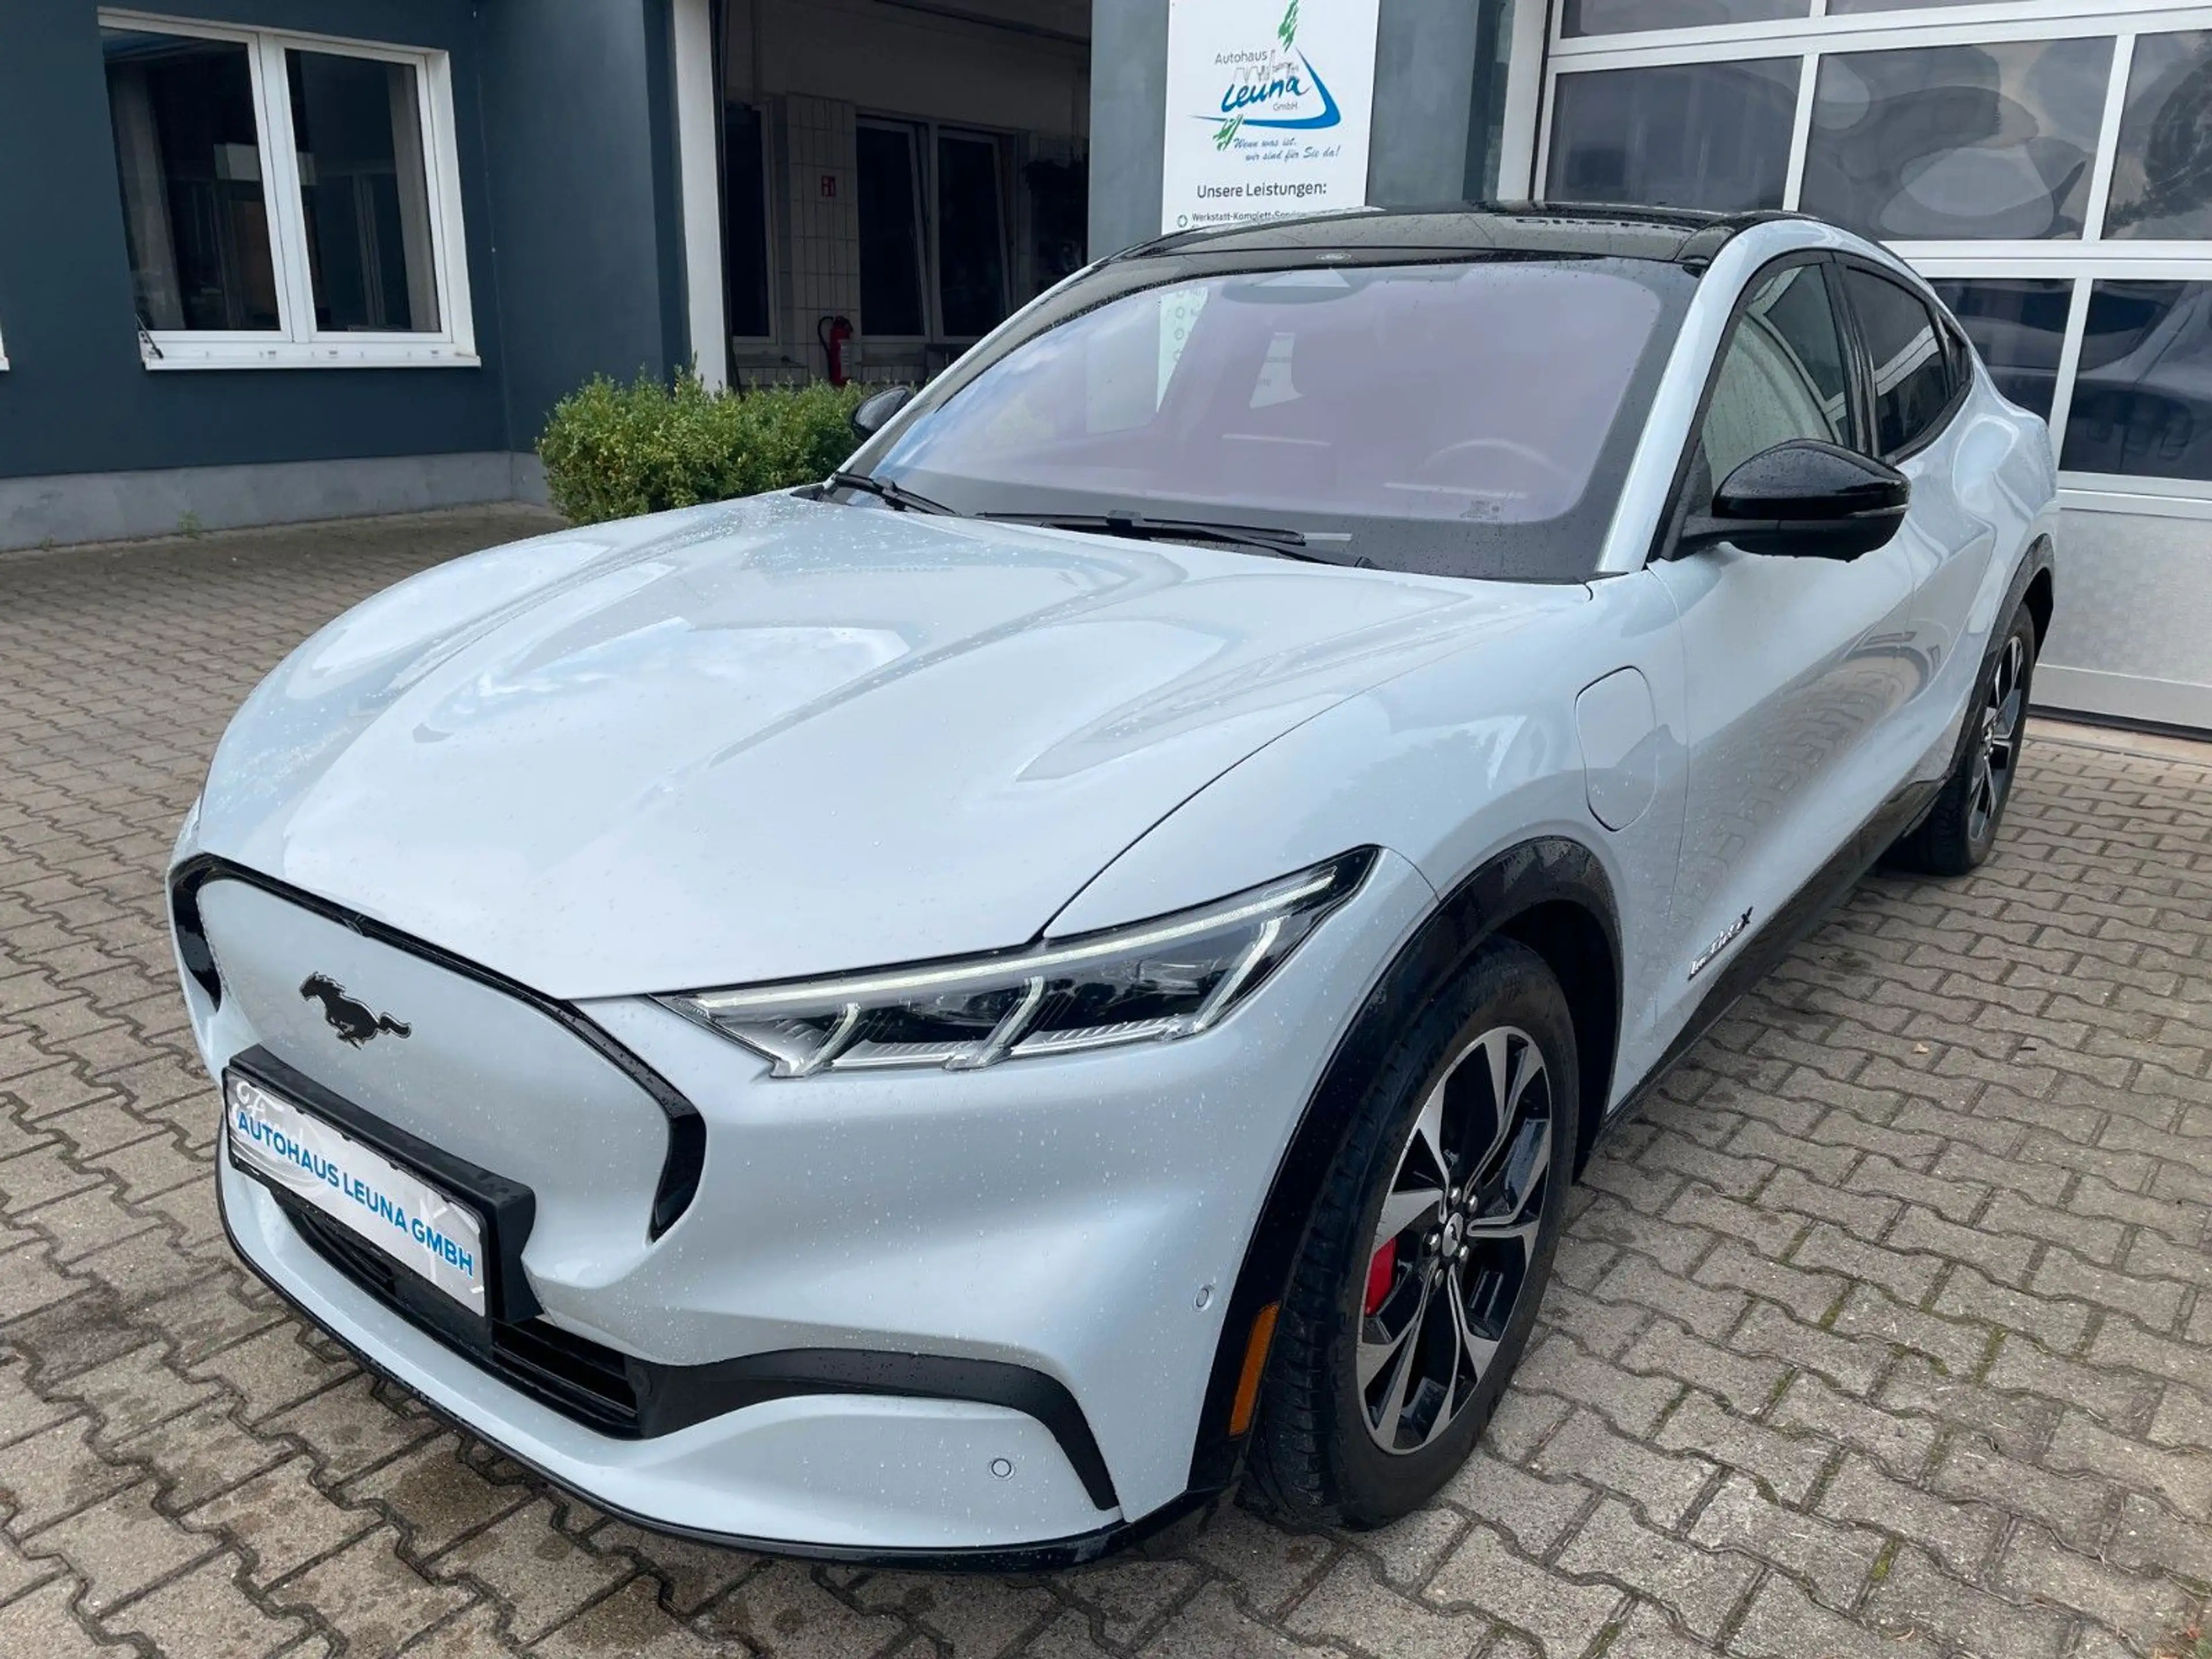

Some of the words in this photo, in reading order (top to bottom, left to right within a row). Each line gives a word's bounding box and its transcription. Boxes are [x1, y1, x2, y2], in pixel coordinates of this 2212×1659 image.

[1215, 50, 1268, 65] Autohaus
[1221, 75, 1311, 113] Leuna
[1273, 102, 1298, 112] GmbH
[1234, 137, 1259, 149] Wenn
[1245, 152, 1260, 162] wir
[1262, 149, 1283, 160] sind
[1284, 149, 1299, 163] für
[1303, 146, 1320, 159] Sie
[1323, 145, 1342, 158] da!
[1196, 184, 1243, 199] Unsere
[1246, 182, 1327, 197] Leistungen:
[238, 1111, 339, 1187] AUTOHAUS
[343, 1172, 408, 1233] LEUNA
[412, 1218, 473, 1277] GMBH
